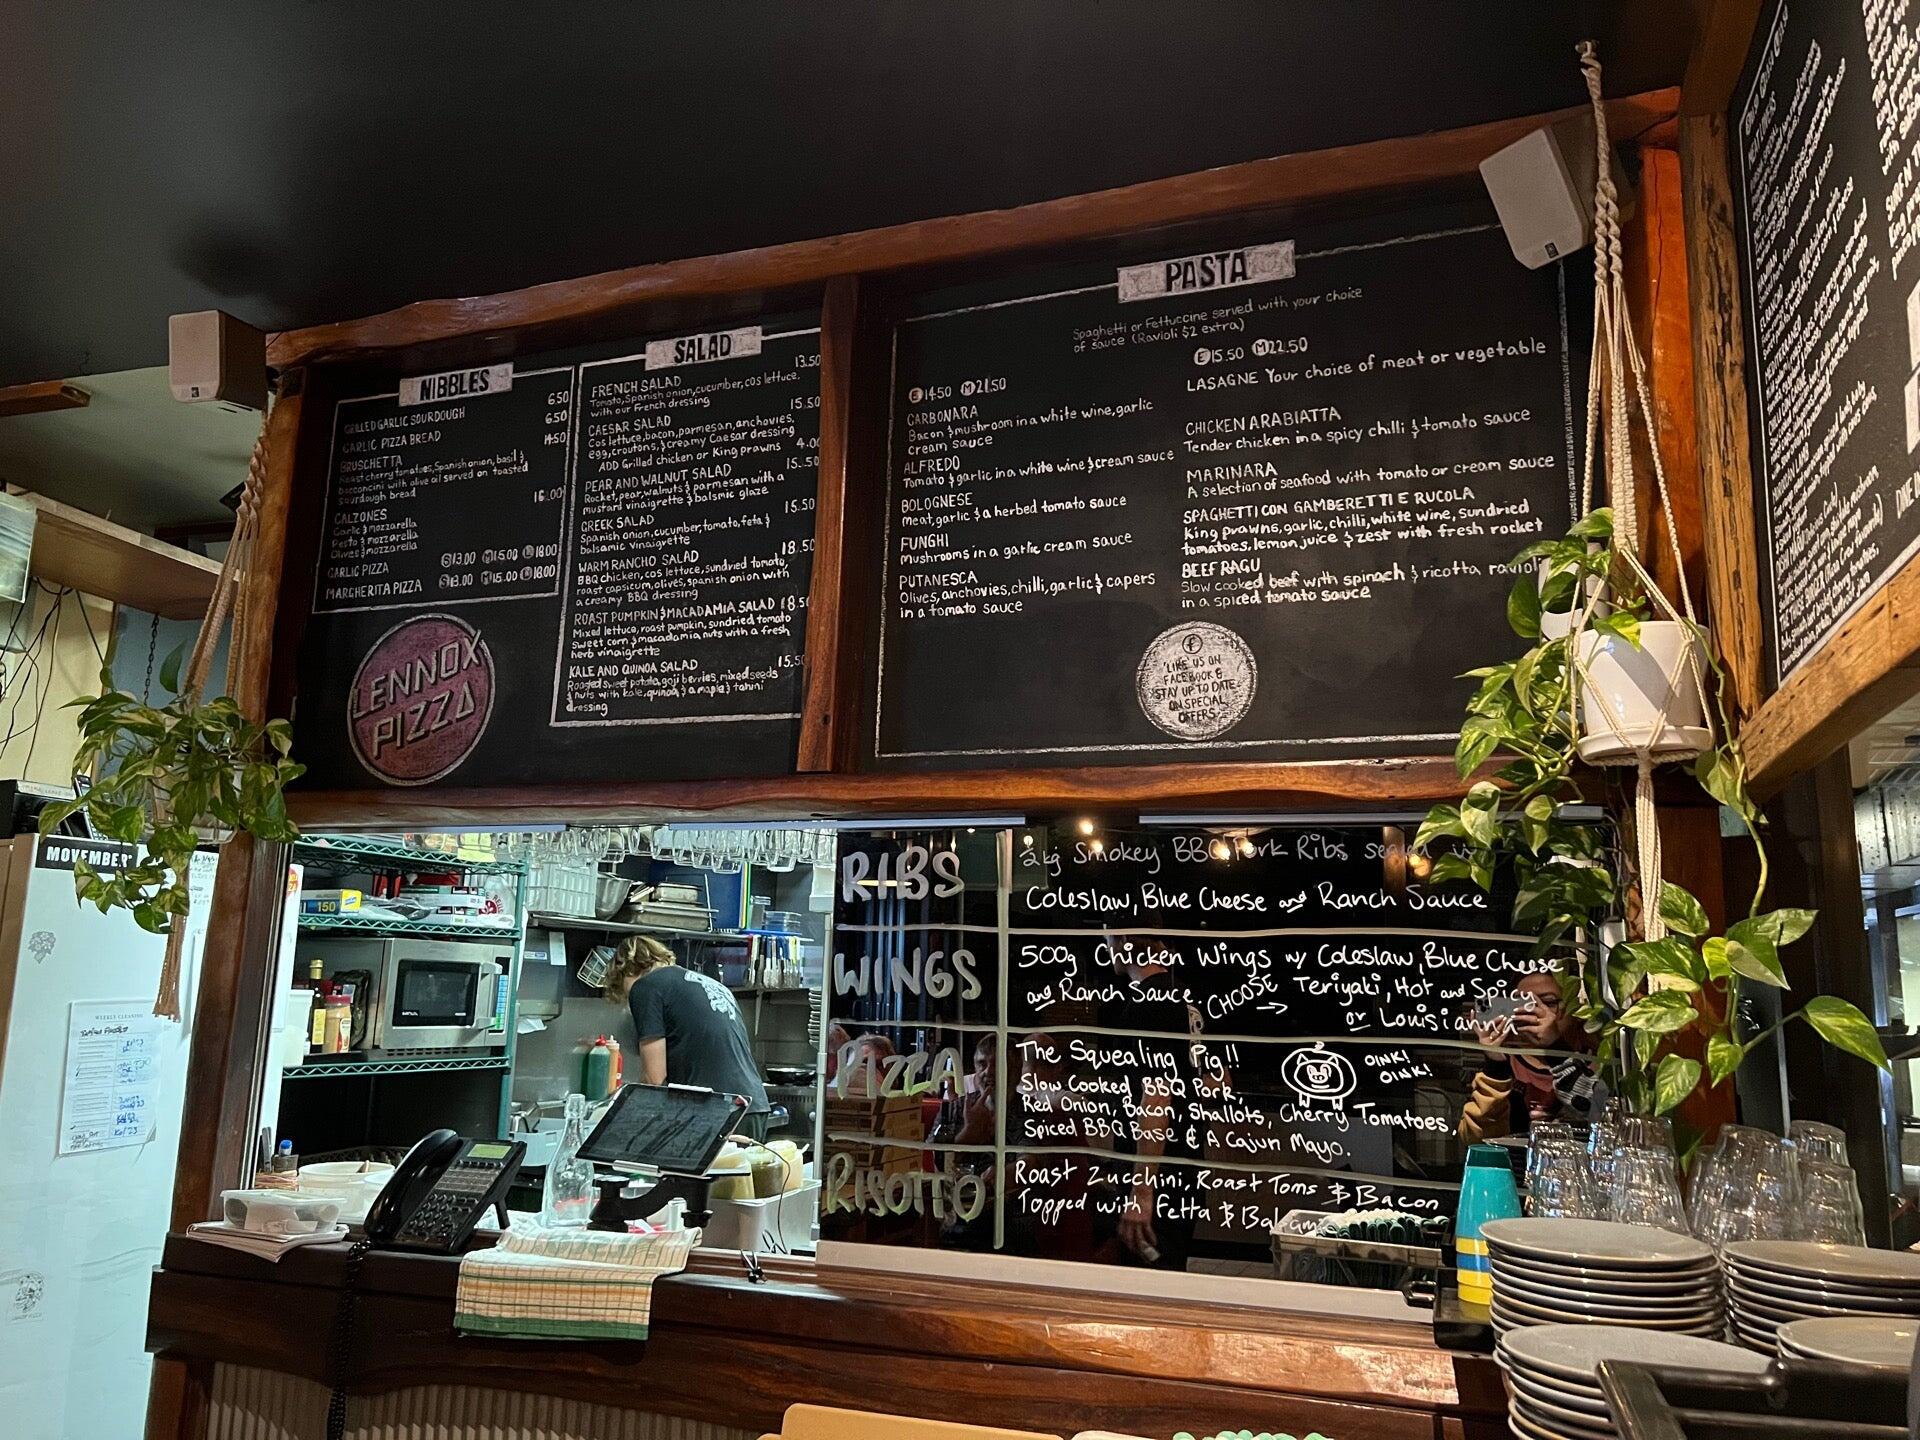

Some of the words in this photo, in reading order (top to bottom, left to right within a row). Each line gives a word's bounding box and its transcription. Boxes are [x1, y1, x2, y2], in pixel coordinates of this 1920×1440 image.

[1166, 251, 1248, 292] PASTA
[1072, 321, 1127, 342] Spaghetti
[1131, 321, 1142, 332] or
[1145, 310, 1207, 330] Fettuccine
[1212, 302, 1253, 319] served
[1258, 296, 1288, 311] with
[1292, 294, 1320, 310] your
[1326, 286, 1362, 303] choice
[673, 334, 731, 364] SALAD
[1187, 371, 1258, 392] LASAGNE
[1265, 368, 1298, 383] Your
[1306, 364, 1353, 379] choice
[1359, 354, 1375, 372] of
[1383, 350, 1425, 368] meat
[1431, 353, 1449, 364] or
[1455, 337, 1546, 363] vegetable
[420, 369, 490, 401] NIBBLES
[592, 383, 638, 398] FRENCH
[641, 376, 681, 392] SALAD
[588, 421, 629, 437] CAESAR
[634, 415, 671, 429] SALAD
[907, 405, 978, 426] CARBONARA
[1186, 417, 1246, 436] CHICKEN
[1250, 406, 1341, 430] ARABIATTA
[381, 435, 407, 449] PIZZA
[410, 431, 441, 445] BREAD
[908, 442, 947, 456] cream
[952, 435, 993, 450] sauce
[340, 455, 402, 473] BRUSCHETTA
[598, 460, 619, 472] ADD
[622, 456, 653, 470] Grilled
[656, 449, 693, 466] chicken
[696, 450, 708, 459] or
[712, 445, 738, 459] King
[740, 442, 781, 456] prawns
[904, 456, 961, 475] ALFREDO
[585, 478, 614, 493] PEAR
[615, 476, 638, 488] AND
[641, 470, 688, 487] WALNUT
[692, 464, 731, 480] SALAD
[1187, 461, 1278, 483] MARINARA
[1187, 487, 1198, 498] A
[1202, 480, 1262, 498] selection
[1264, 478, 1277, 491] of
[1280, 470, 1331, 488] seafood
[1337, 470, 1370, 485] with
[1377, 464, 1428, 481] tomato
[1432, 467, 1448, 477] or
[1454, 462, 1501, 474] cream
[1509, 455, 1555, 470] sauce
[334, 508, 387, 524] CALZONES
[902, 492, 973, 513] BOLOGNESE
[1183, 505, 1258, 524] SPAGHETTI
[1261, 503, 1288, 517] CON
[1414, 486, 1475, 504] RUCOLA
[581, 519, 614, 532] GREEK
[616, 514, 654, 529] SALAD
[901, 533, 949, 551] FUNGHI
[974, 545, 986, 558] in
[989, 549, 998, 557] a
[1003, 540, 1041, 560] garlic
[1044, 538, 1087, 552] cream
[1092, 532, 1133, 547] sauce
[328, 564, 360, 578] GARLIC
[362, 562, 389, 576] PIZZA
[900, 570, 978, 590] PUTANESCA
[1182, 562, 1217, 578] BEEF
[1221, 558, 1261, 575] RAGU
[326, 581, 391, 599] MARGHERITA
[393, 579, 422, 593] PIZZA
[900, 607, 913, 619] in
[918, 609, 925, 618] a
[931, 603, 977, 616] tomato
[983, 600, 1023, 614] sauce
[351, 629, 481, 720] LENNOX
[569, 666, 594, 679] KALE
[597, 666, 619, 676] AND
[622, 662, 657, 676] QUINOA
[660, 659, 698, 672] SALAD
[1156, 687, 1178, 699] STAY
[1182, 686, 1194, 695] UP
[1196, 684, 1208, 693] TO
[1212, 679, 1236, 691] DATE
[373, 680, 476, 760] PIZZA
[1297, 833, 1349, 861] Ribs
[842, 847, 964, 902] RIBS
[318, 901, 335, 912] 150
[1141, 883, 1191, 909] Blue
[1199, 887, 1267, 911] Cheese
[1317, 881, 1397, 908] Ranch
[1407, 884, 1488, 909] Sauce
[834, 947, 982, 1000] WINGS
[1019, 945, 1078, 977] 500g
[1094, 942, 1184, 967] Chicken
[1198, 942, 1271, 978] Wings
[1424, 942, 1479, 969] Blue
[1486, 949, 1563, 974] Cheese
[1060, 978, 1125, 1001] Ranch
[1206, 974, 1278, 1019] CHOOSE
[1395, 978, 1435, 998] Hot
[1440, 986, 1465, 999] and
[1473, 979, 1537, 1011] Spicy
[1346, 1010, 1371, 1031] or
[837, 1039, 965, 1100] PIZZA
[1015, 1041, 1062, 1064] The
[1069, 1039, 1177, 1082] Squealing
[1191, 1044, 1241, 1081] Pig!!
[1365, 1050, 1411, 1067] OINK!
[1021, 1072, 1062, 1092] Slow
[1068, 1074, 1131, 1098] Cooked
[1143, 1076, 1186, 1099] BBQ
[1380, 1063, 1434, 1083] OINK!
[1022, 1097, 1053, 1114] Red
[1061, 1097, 1118, 1117] Onion,
[1123, 1097, 1182, 1122] Bacon,
[1189, 1102, 1273, 1129] Shallots,
[1280, 1104, 1349, 1132] Cherry
[1354, 1102, 1458, 1136] Tomatoes,
[1024, 1118, 1078, 1140] Spiced
[1084, 1117, 1124, 1137] BBQ
[1131, 1120, 1179, 1142] Base
[1206, 1132, 1220, 1147] A
[1226, 1131, 1281, 1152] Cajun
[828, 1153, 986, 1222] RISOTTO
[1015, 1159, 1079, 1186] Roast
[1196, 1170, 1262, 1191] Roast
[1269, 1173, 1317, 1196] Toms
[1356, 1185, 1439, 1211] Bacon
[1018, 1192, 1086, 1226] Topped
[1097, 1195, 1141, 1214] with
[1157, 1195, 1211, 1221] Fetta
